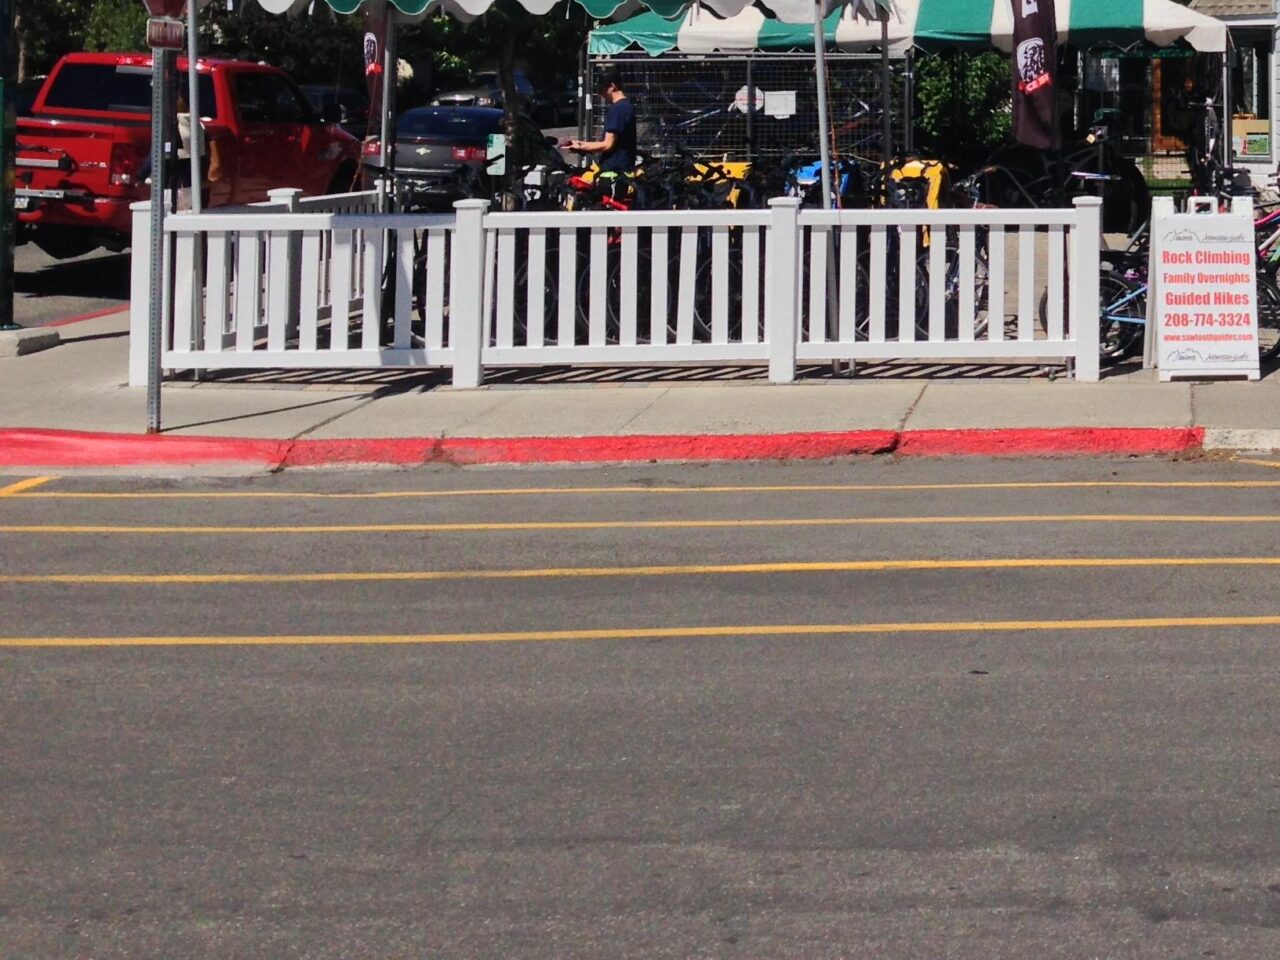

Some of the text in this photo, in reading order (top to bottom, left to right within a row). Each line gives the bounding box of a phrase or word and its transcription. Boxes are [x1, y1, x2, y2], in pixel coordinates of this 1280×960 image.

[1162, 250, 1250, 265] Rock Climbing
[1163, 272, 1250, 284] Family Overnights
[1165, 292, 1249, 305] Guided Hikes
[1164, 313, 1251, 327] 208-774-3324
